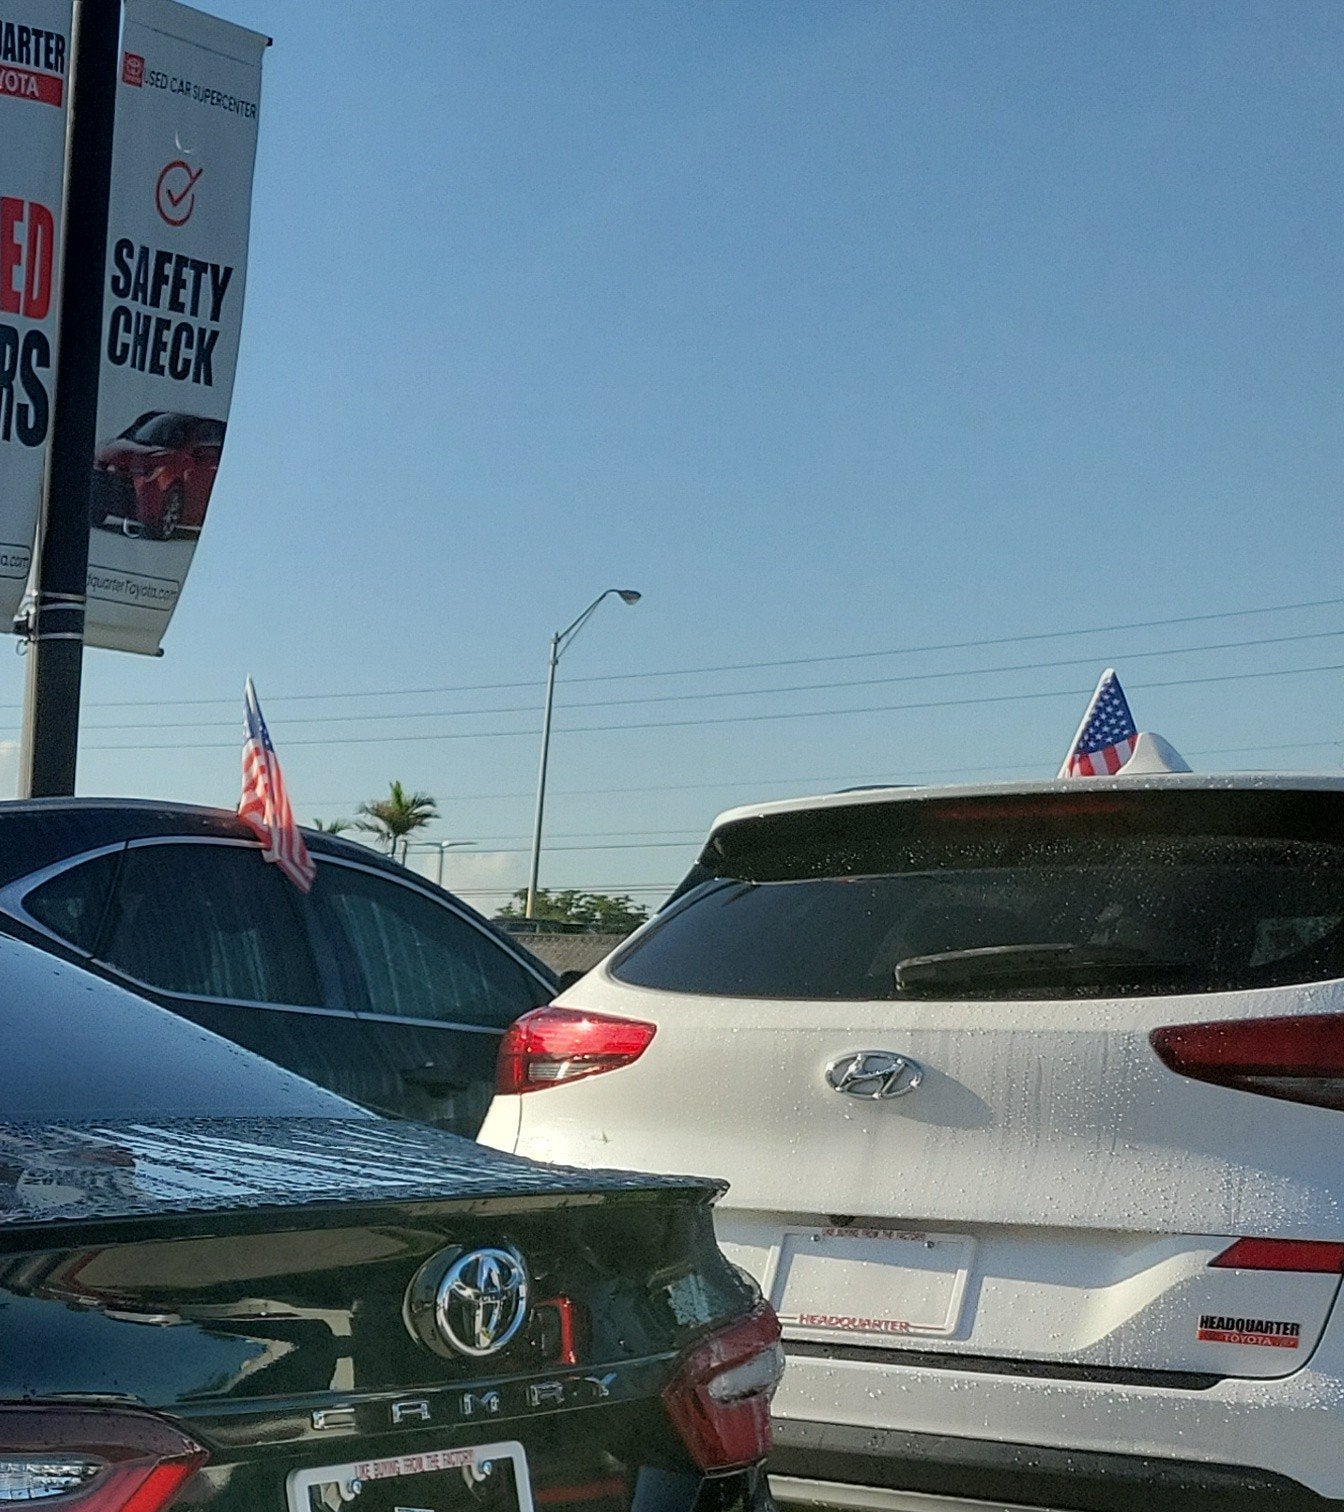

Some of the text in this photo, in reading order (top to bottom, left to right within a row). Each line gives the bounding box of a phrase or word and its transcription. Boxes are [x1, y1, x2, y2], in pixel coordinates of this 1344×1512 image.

[145, 70, 168, 90] SED
[193, 85, 257, 119] SUPERCENTER
[111, 238, 234, 322] SAFETY
[107, 305, 220, 387] CHECK
[798, 1314, 911, 1333] HEADQUARTER
[1199, 1315, 1301, 1336] HEADQUARTER
[1223, 1332, 1273, 1346] TOYOTA
